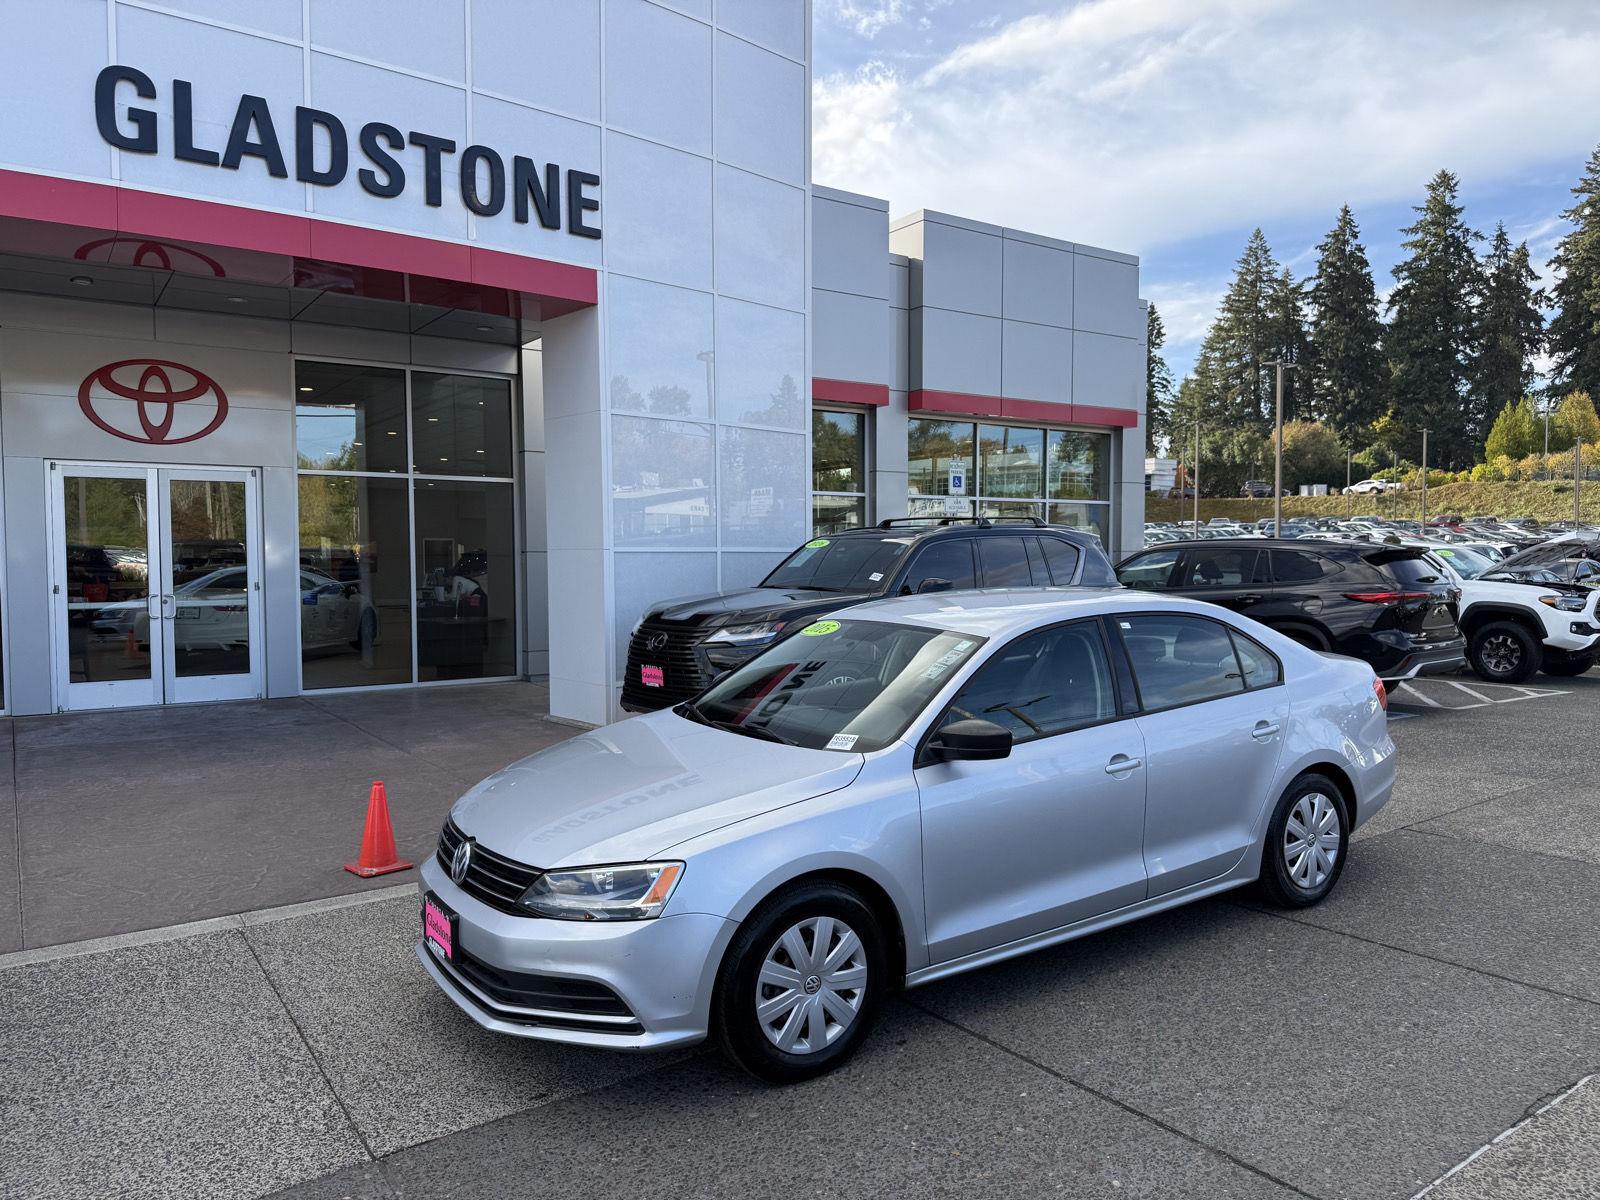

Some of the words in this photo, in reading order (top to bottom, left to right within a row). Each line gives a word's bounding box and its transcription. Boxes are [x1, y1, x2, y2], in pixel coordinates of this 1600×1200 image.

[95, 65, 602, 240] GLADSTONE
[803, 622, 837, 634] 2015
[427, 912, 452, 945] Gladstone
